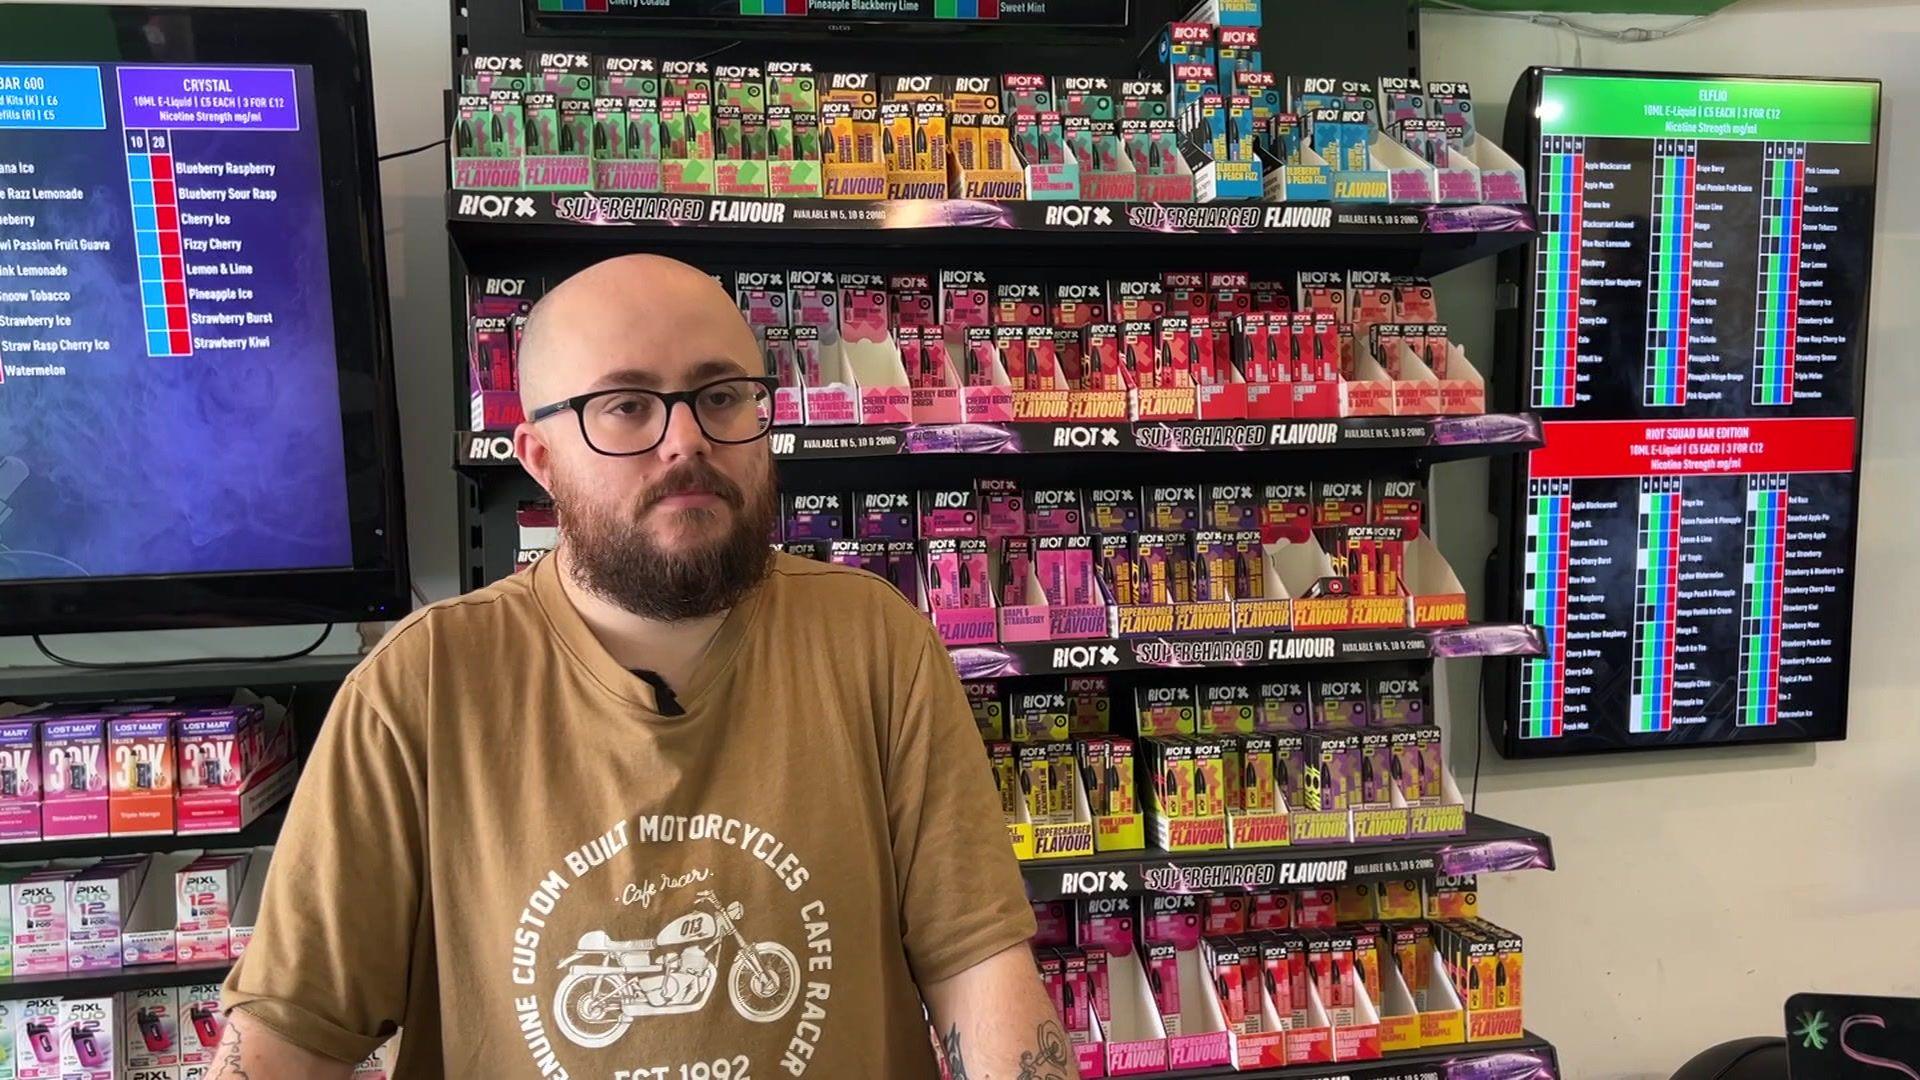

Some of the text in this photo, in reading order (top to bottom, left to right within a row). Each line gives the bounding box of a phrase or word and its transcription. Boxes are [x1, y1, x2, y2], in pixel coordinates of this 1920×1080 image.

[808, 0, 919, 12] Pineapple Blackberry Lime
[1000, 2, 1046, 13] Sweet Mint
[24, 77, 44, 90] 600
[183, 79, 232, 92] CRYSTAL
[832, 74, 868, 89] RIOT
[956, 78, 991, 93] RIOT
[1304, 78, 1335, 93] RIOT
[134, 96, 156, 107] 10ML
[212, 97, 235, 108] EACH
[243, 98, 249, 108] 3
[250, 98, 267, 108] FOR
[159, 111, 195, 122] Nicotine
[196, 112, 233, 124] Strength
[1665, 121, 1697, 132] Nicotine
[1698, 122, 1731, 135] Strength
[131, 136, 143, 148] 10
[152, 136, 165, 148] 20
[19, 162, 35, 173] Ice
[175, 162, 276, 176] Blueberry Raspberry
[7, 188, 84, 199] Razz Lemonade
[826, 177, 885, 196] FLAVOUR
[966, 181, 1022, 198] FLAVOUR
[1334, 182, 1387, 198] FLAVOUR
[178, 188, 277, 202] Blueberry Sour Rasp
[458, 196, 512, 219] RIOT
[560, 197, 705, 221] SUPERCHARGED
[709, 201, 786, 223] FLAVOUR
[793, 210, 829, 220] AVAILABLE
[0, 213, 35, 227] ueberry
[181, 213, 231, 227] Cherry Ice
[1045, 205, 1091, 228] RIOT
[1130, 206, 1261, 229] SUPERCHARGED
[1264, 207, 1332, 229] FLAVOUR
[13, 239, 110, 250] Passion Fruit Guava
[184, 238, 242, 252] Fizzy Cherry
[0, 264, 68, 276] ink Lemonade
[186, 263, 253, 275] Lemon & Lime
[189, 288, 253, 301] Pineapple Ice
[486, 279, 525, 296] RIOT
[30, 290, 71, 301] Tobacco
[0, 315, 72, 328] Strawberry Ice
[191, 312, 273, 326] Strawberry Burst
[2, 339, 110, 353] Straw Rasp Cherry Ice
[194, 336, 270, 350] Strawberry Kiwi
[4, 364, 66, 376] Watermelon
[1013, 401, 1068, 419] FLAVOUR
[1139, 398, 1195, 416] FLAVOUR
[1053, 423, 1338, 448] RIOT SUPERCHARGED FLAVOUR
[1645, 427, 1749, 440] RIOT SQUAD BAR EDITION
[470, 437, 516, 460] RIO
[935, 491, 970, 508] RIOT
[1236, 609, 1290, 629] FLAVOUR
[1416, 604, 1466, 621] FLAVOUR
[938, 621, 995, 640] FLAVOUR
[1119, 614, 1174, 633] FLAVOUR
[1052, 638, 1335, 668] RIOT SUPERCHARGED FLAVOUR
[48, 724, 97, 734] LOST MARY
[115, 723, 162, 732] LOST MARY
[183, 721, 230, 731] LOST MARY
[1036, 834, 1091, 854] FLAVOUR
[186, 876, 217, 885] PIXL
[1061, 860, 1348, 894] RIOT SUPERCHARGED FLAVOUR
[22, 888, 52, 897] PIXL
[189, 893, 216, 906] 12
[621, 879, 657, 909] Cafe
[680, 917, 704, 936] 013
[511, 813, 833, 1080] NUINE CUSTOM BUILT MOTORCYCLES CAFE RACER
[71, 1003, 102, 1012] PIXL
[1471, 1018, 1522, 1038] FLAVOUR
[678, 1055, 750, 1080] 1992
